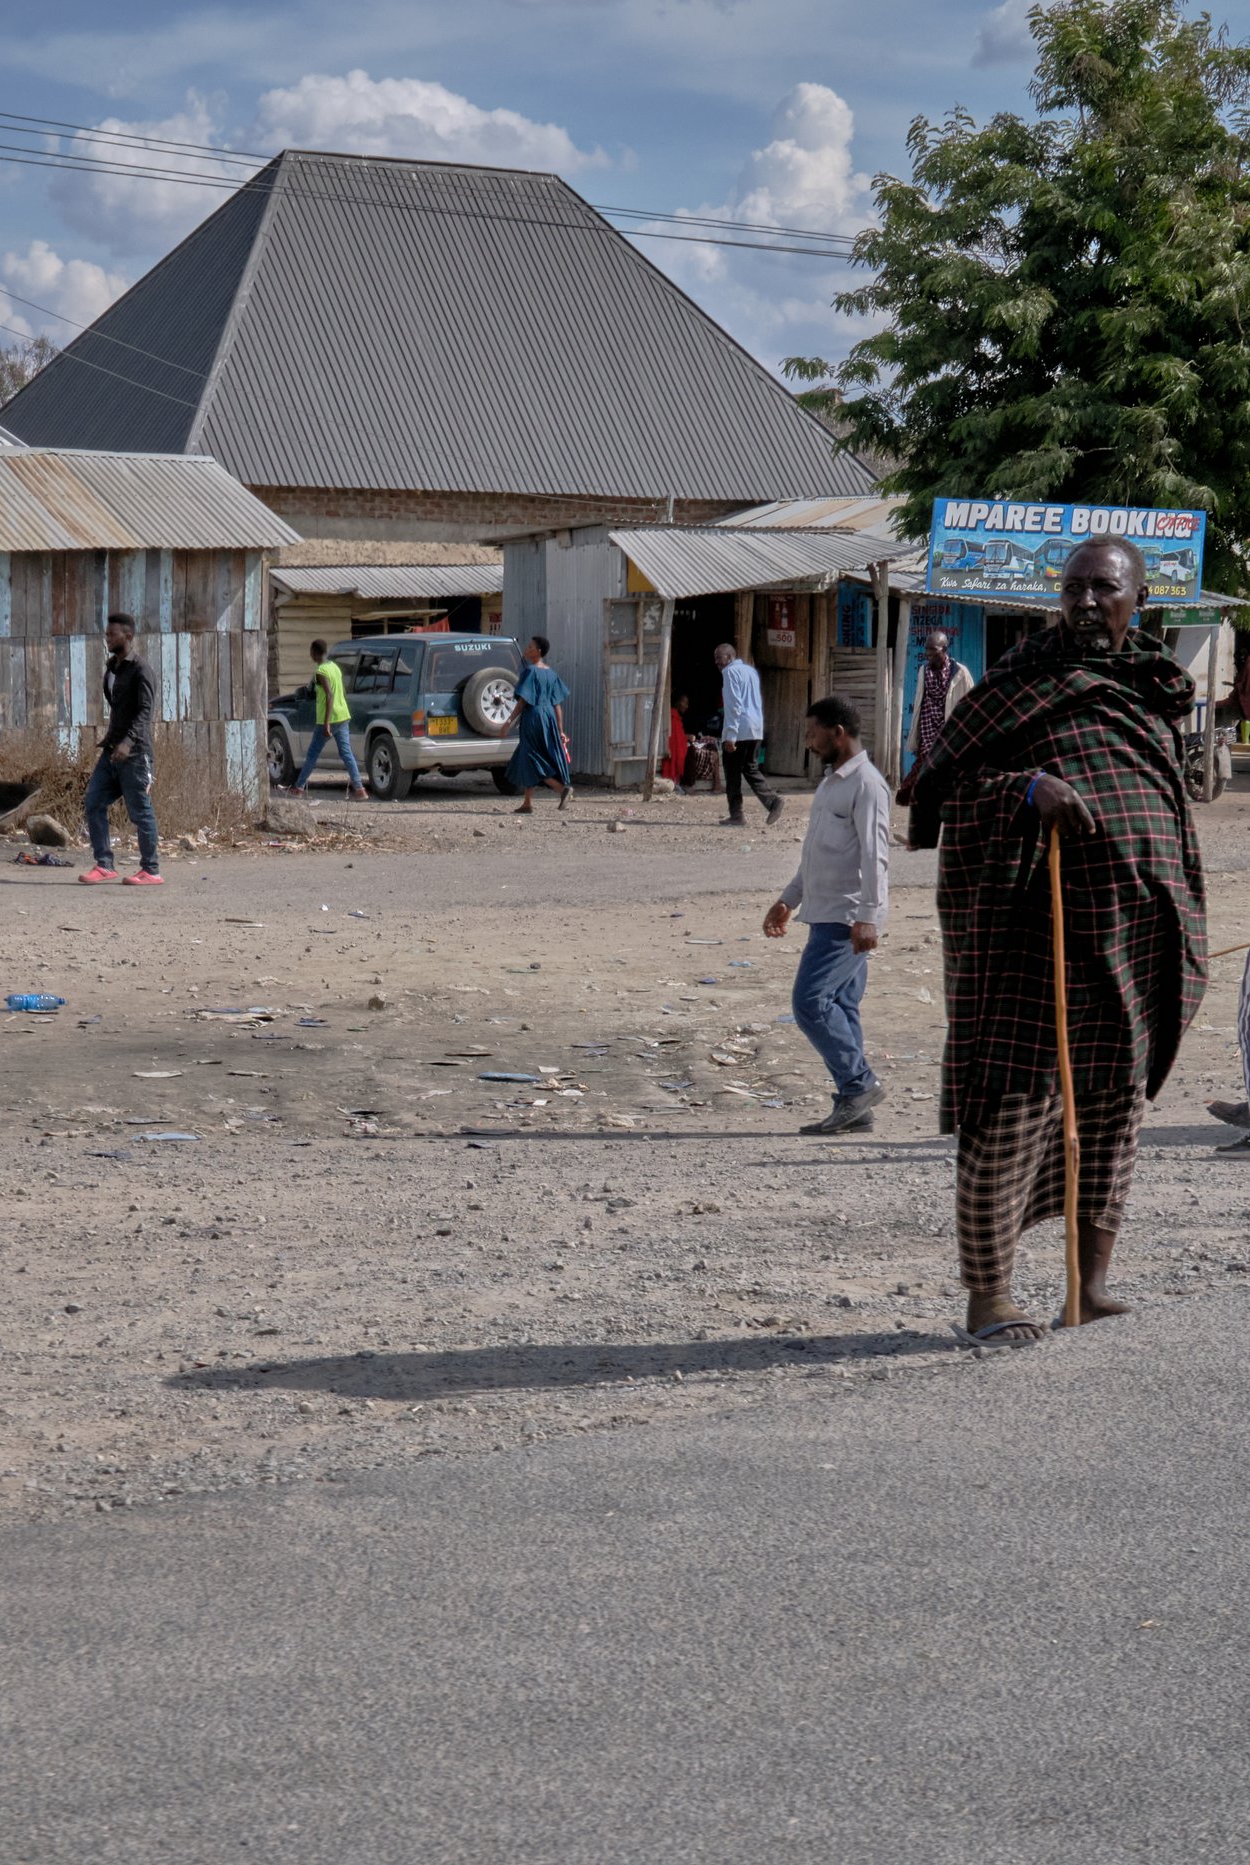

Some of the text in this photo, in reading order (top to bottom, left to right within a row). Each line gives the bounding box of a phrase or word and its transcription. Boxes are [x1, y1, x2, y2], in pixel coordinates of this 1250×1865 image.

[943, 501, 1194, 538] MPAREE BOOKING
[939, 576, 958, 588] Kwa
[961, 577, 991, 590] Safari
[995, 582, 1007, 590] za
[1010, 580, 1047, 593] haraka,
[776, 634, 792, 643] 500
[454, 643, 491, 652] SUZUKI
